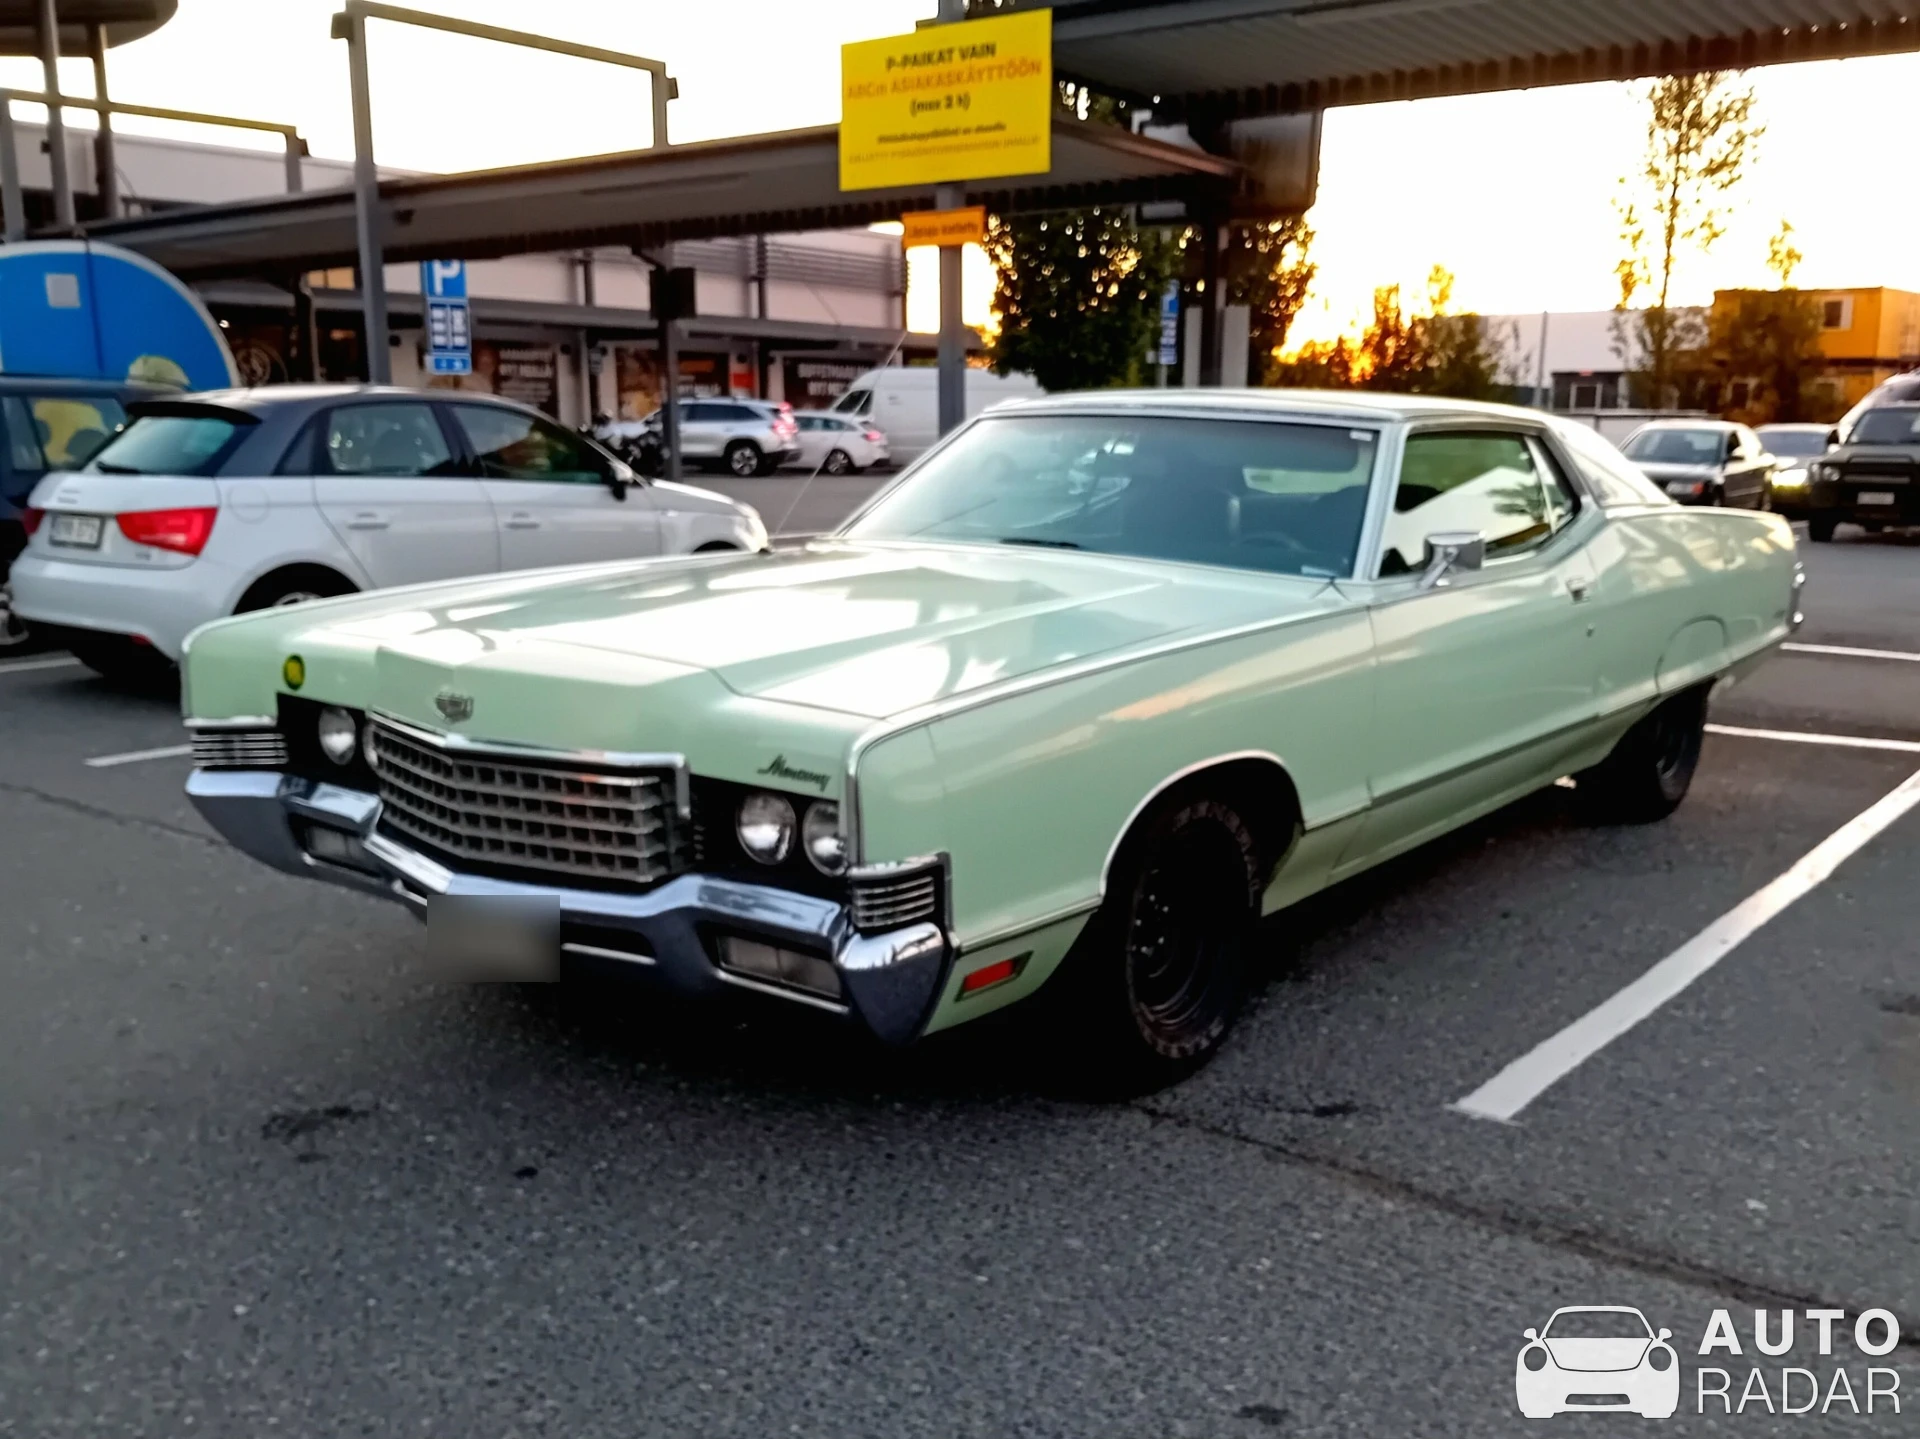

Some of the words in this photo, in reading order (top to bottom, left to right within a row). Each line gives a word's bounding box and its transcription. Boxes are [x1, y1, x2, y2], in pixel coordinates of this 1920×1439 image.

[886, 47, 954, 72] P-PAIKAT
[958, 42, 997, 61] VAIN
[432, 258, 461, 295] P
